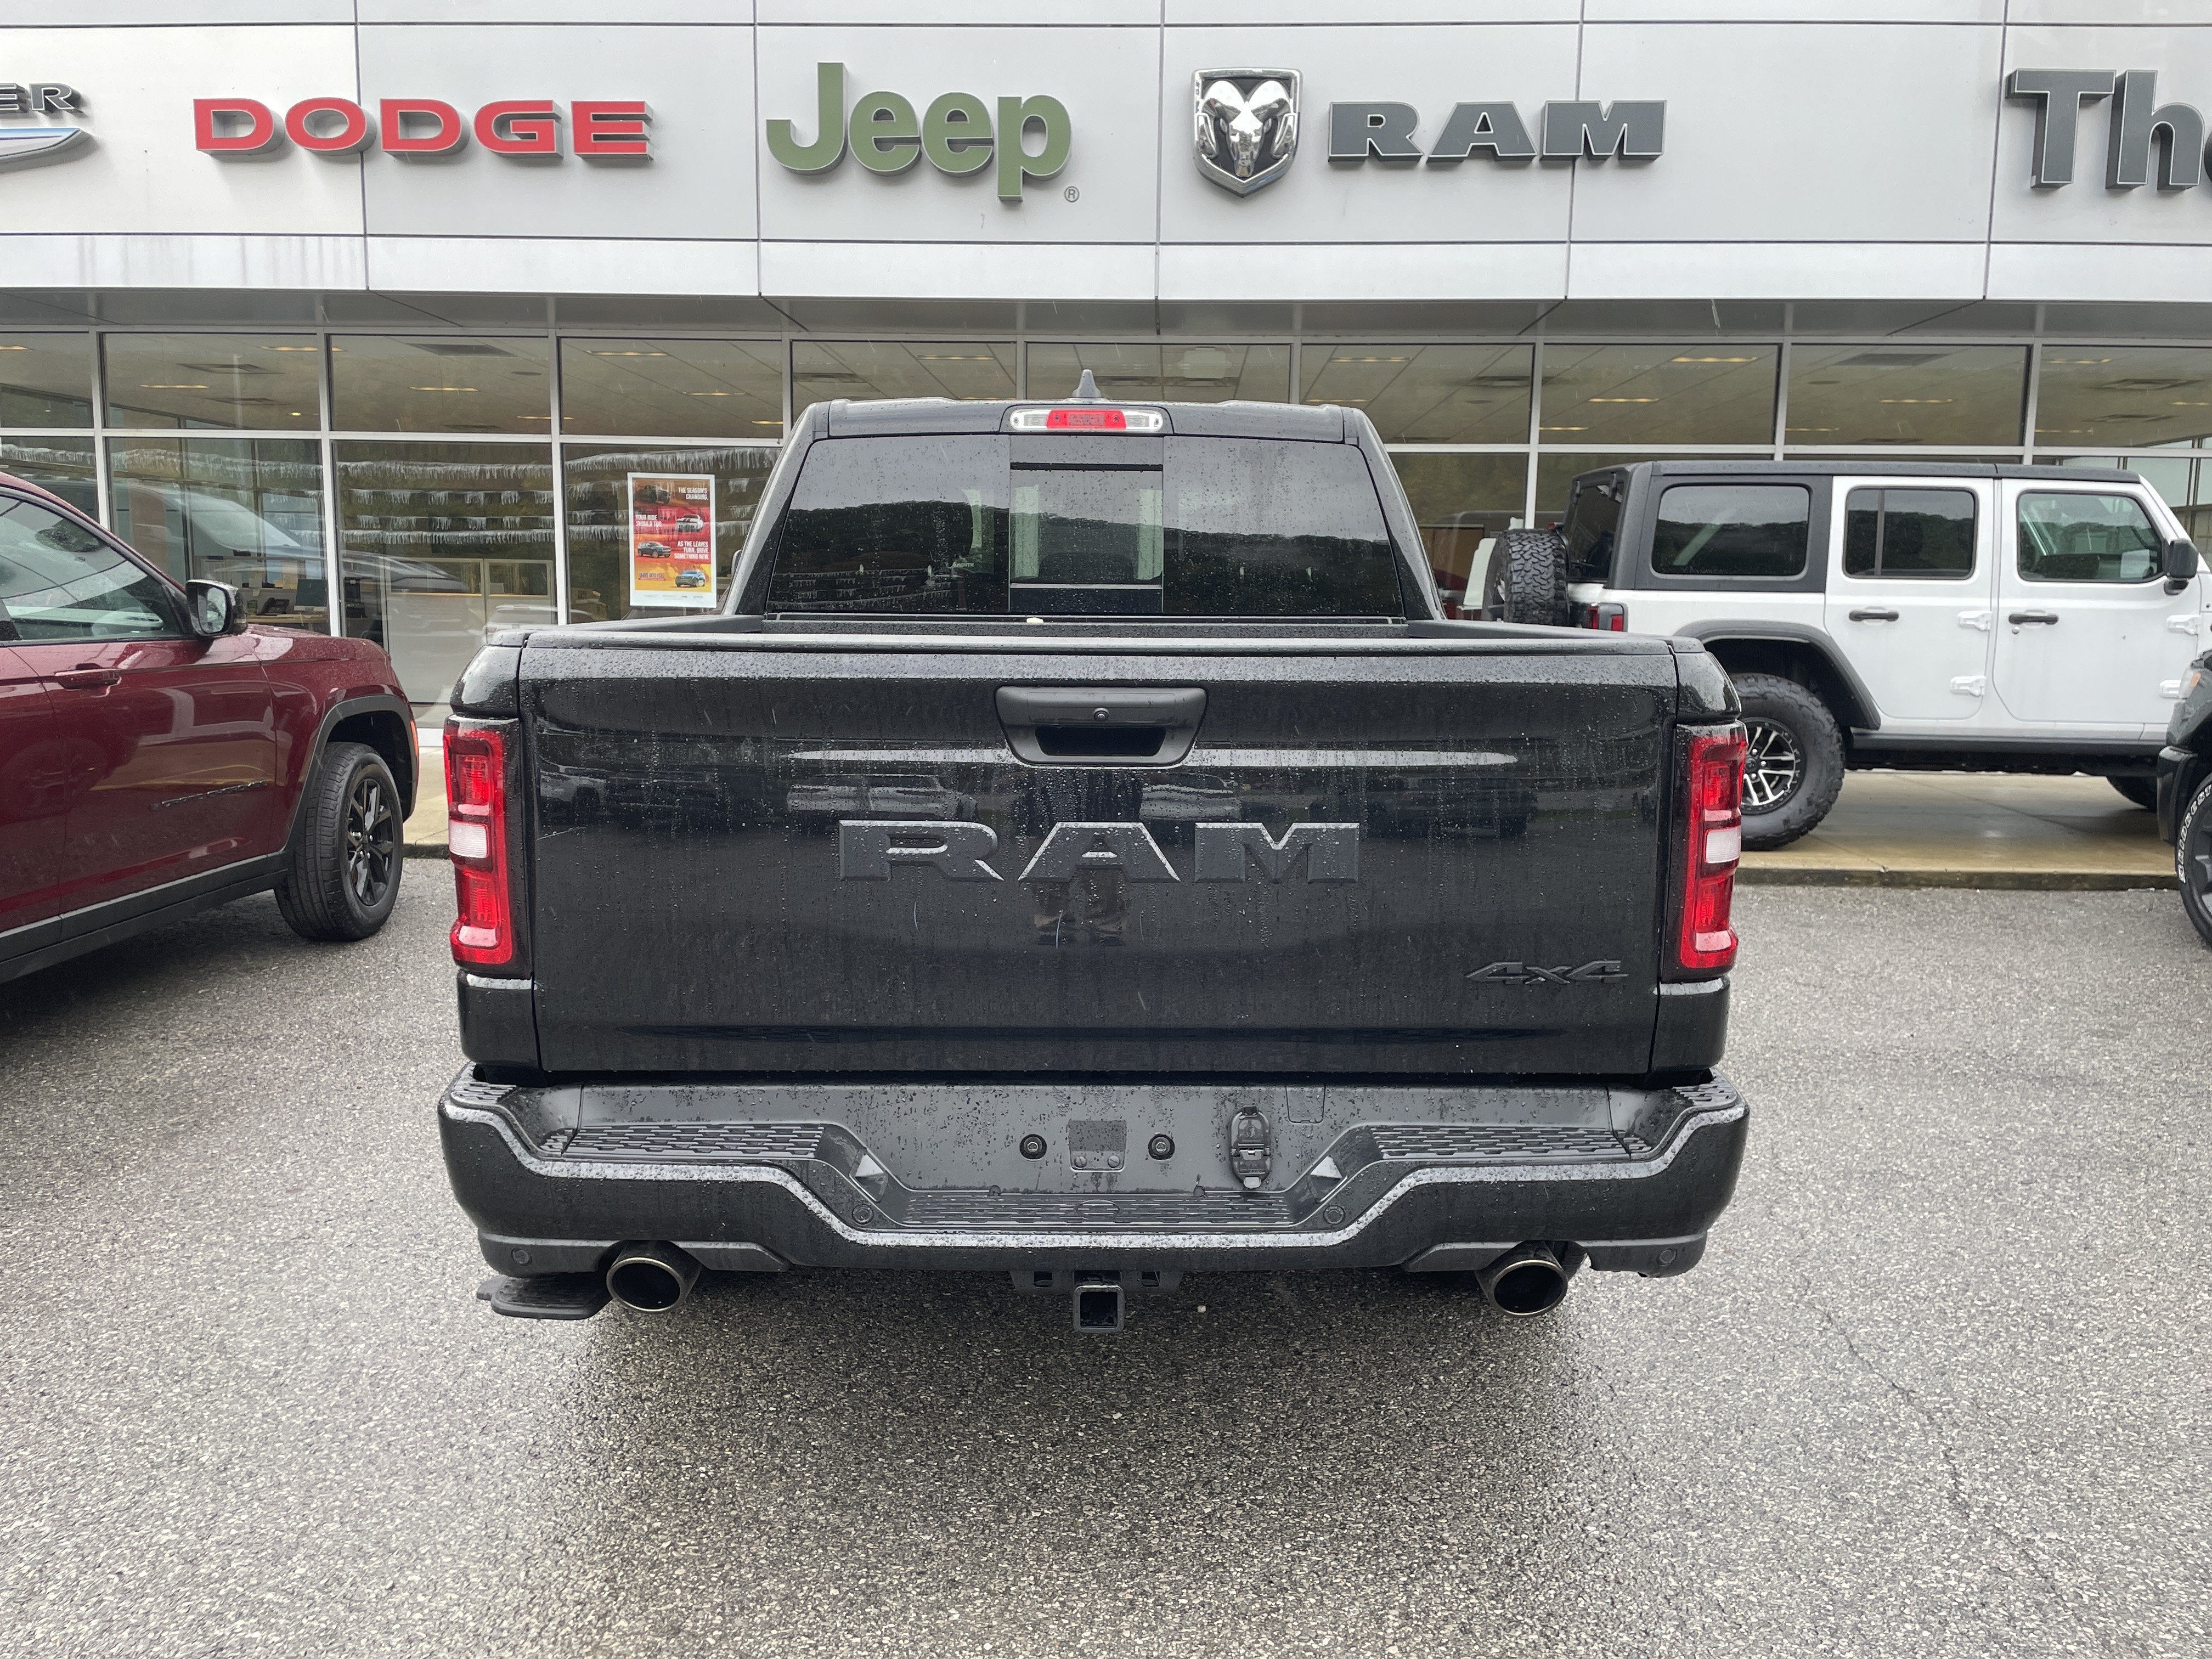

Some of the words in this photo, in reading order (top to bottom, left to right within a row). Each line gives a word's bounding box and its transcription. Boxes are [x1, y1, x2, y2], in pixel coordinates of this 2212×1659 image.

[193, 97, 652, 160] DODGE
[766, 61, 1071, 201] Jeep
[1328, 100, 1667, 162] RAM
[2005, 68, 2212, 190] Th
[838, 819, 1360, 883] RAM
